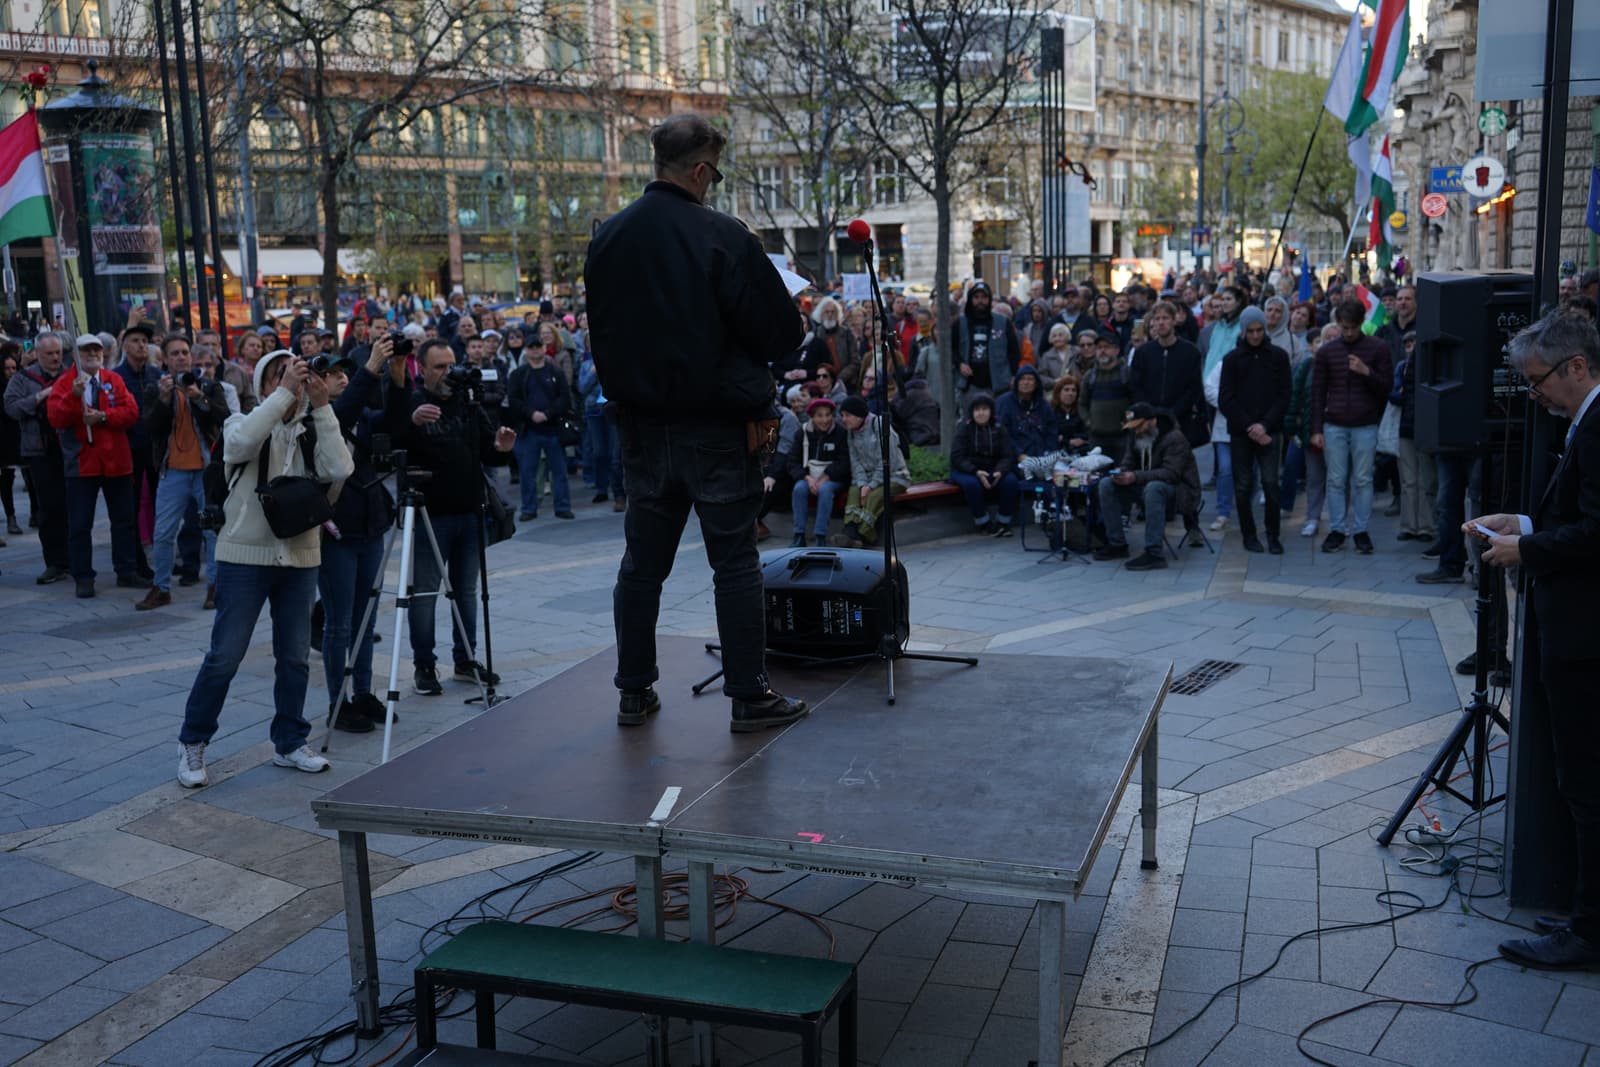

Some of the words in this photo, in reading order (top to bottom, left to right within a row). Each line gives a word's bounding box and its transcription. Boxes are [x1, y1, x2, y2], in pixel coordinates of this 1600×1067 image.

[431, 829, 480, 840] PLATFORMS
[492, 835, 523, 843] STAGES
[809, 865, 867, 878] PLATFORMS
[881, 873, 918, 884] STAGES
